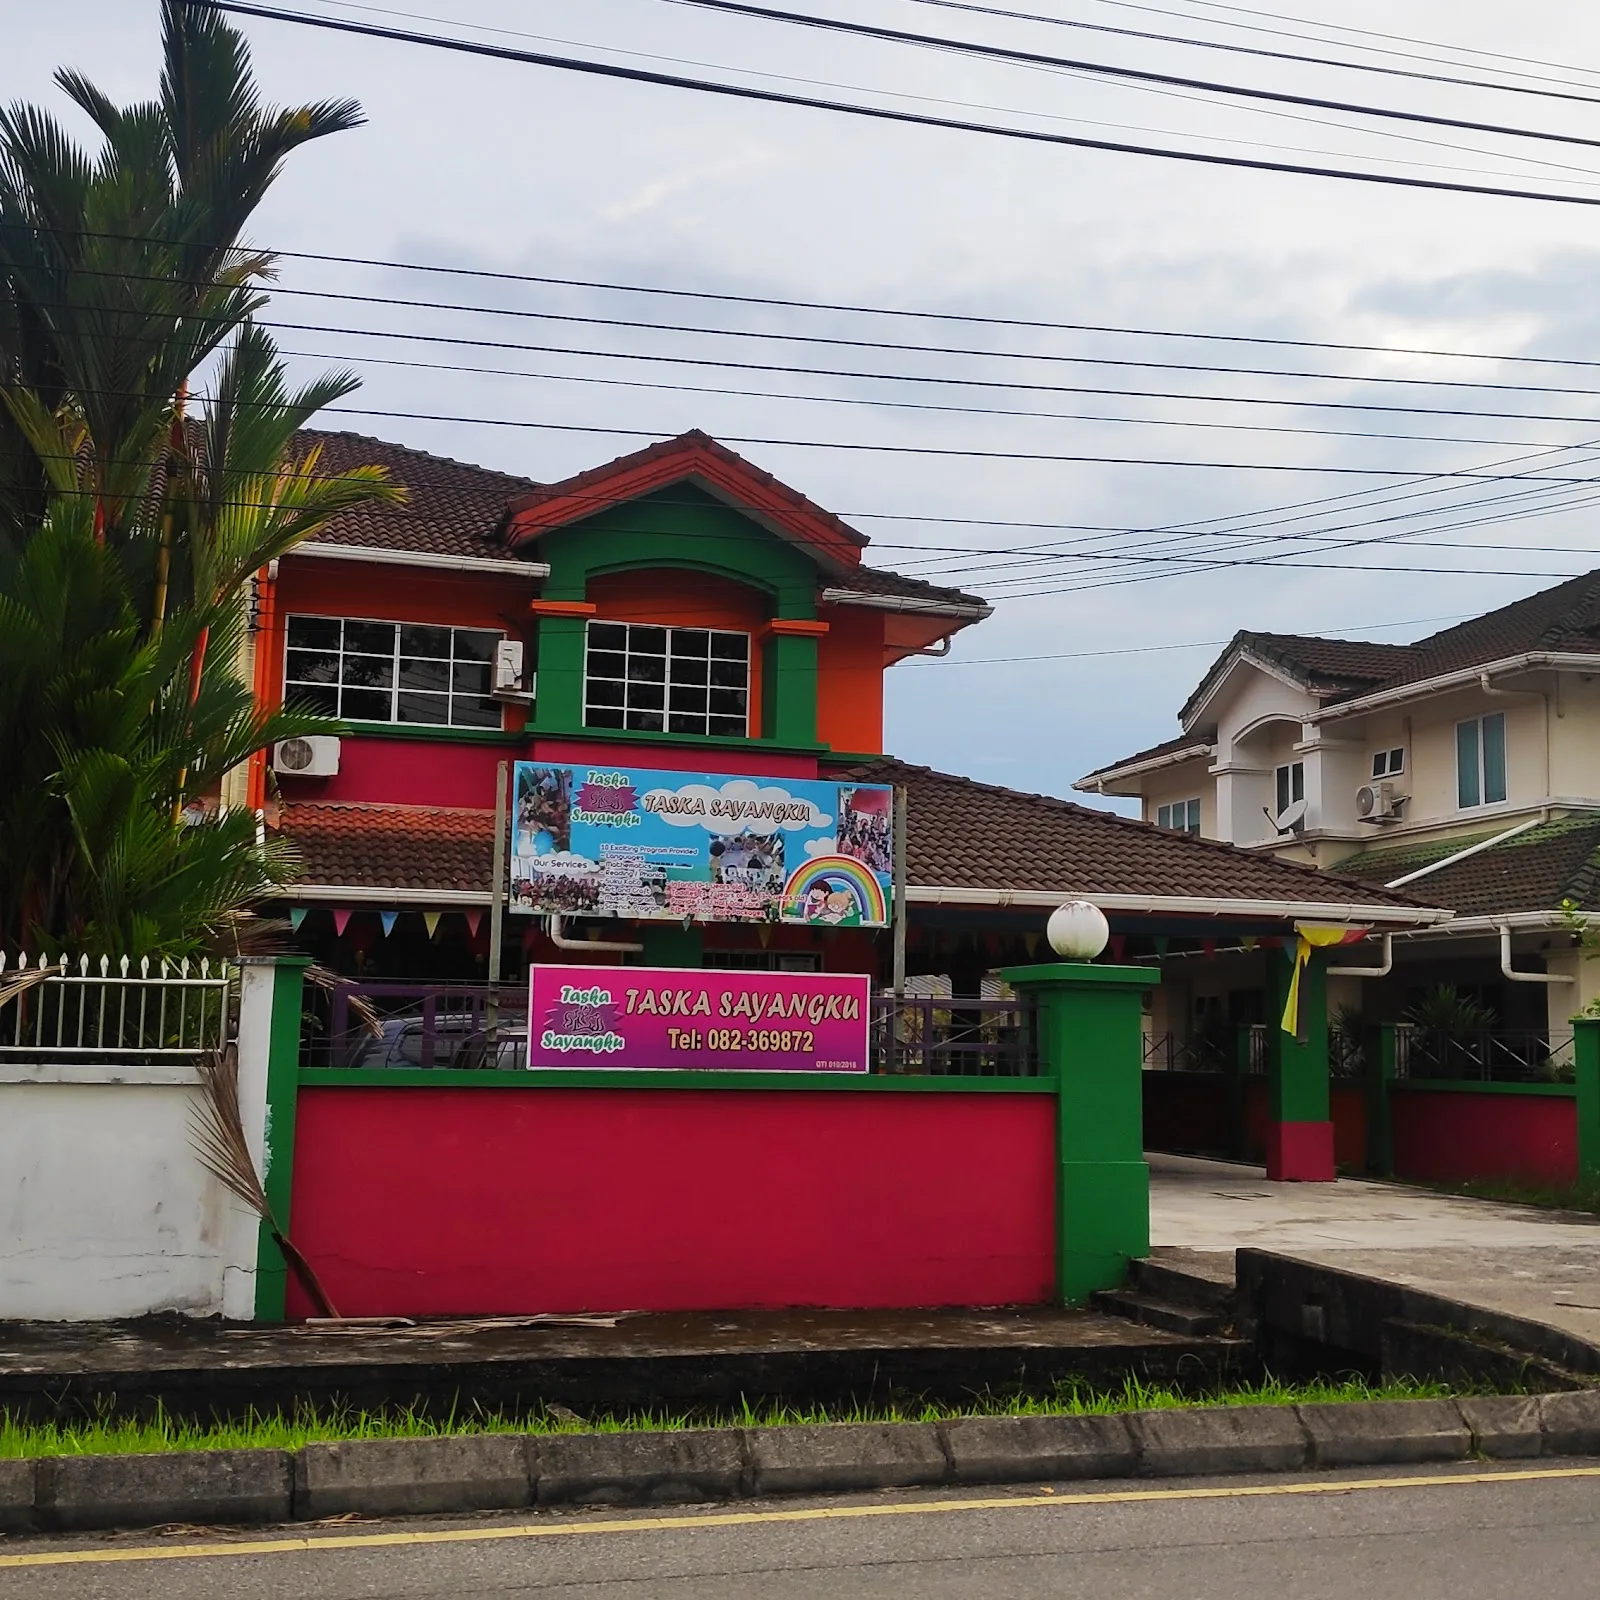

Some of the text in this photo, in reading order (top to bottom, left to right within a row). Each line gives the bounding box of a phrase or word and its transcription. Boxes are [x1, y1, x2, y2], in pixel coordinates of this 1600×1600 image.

[588, 771, 628, 786] Taska
[645, 795, 810, 824] TASKA SAYANGKU
[572, 809, 640, 827] Sayangku
[610, 844, 638, 853] Exciting
[640, 846, 667, 854] Program
[669, 847, 698, 855] Provided
[606, 853, 644, 861] Languages
[533, 859, 587, 869] Our Services
[605, 861, 652, 869] Mathematics
[605, 870, 633, 878] Reading
[670, 881, 693, 889] Infant
[632, 887, 651, 895] Craft
[604, 894, 655, 904] Music Program
[633, 904, 661, 912] Program
[562, 987, 609, 1006] Taska
[625, 989, 860, 1025] TASKA SAYANGKU
[542, 1031, 624, 1052] Sayangku
[667, 1028, 814, 1052] Tel: 082-369872
